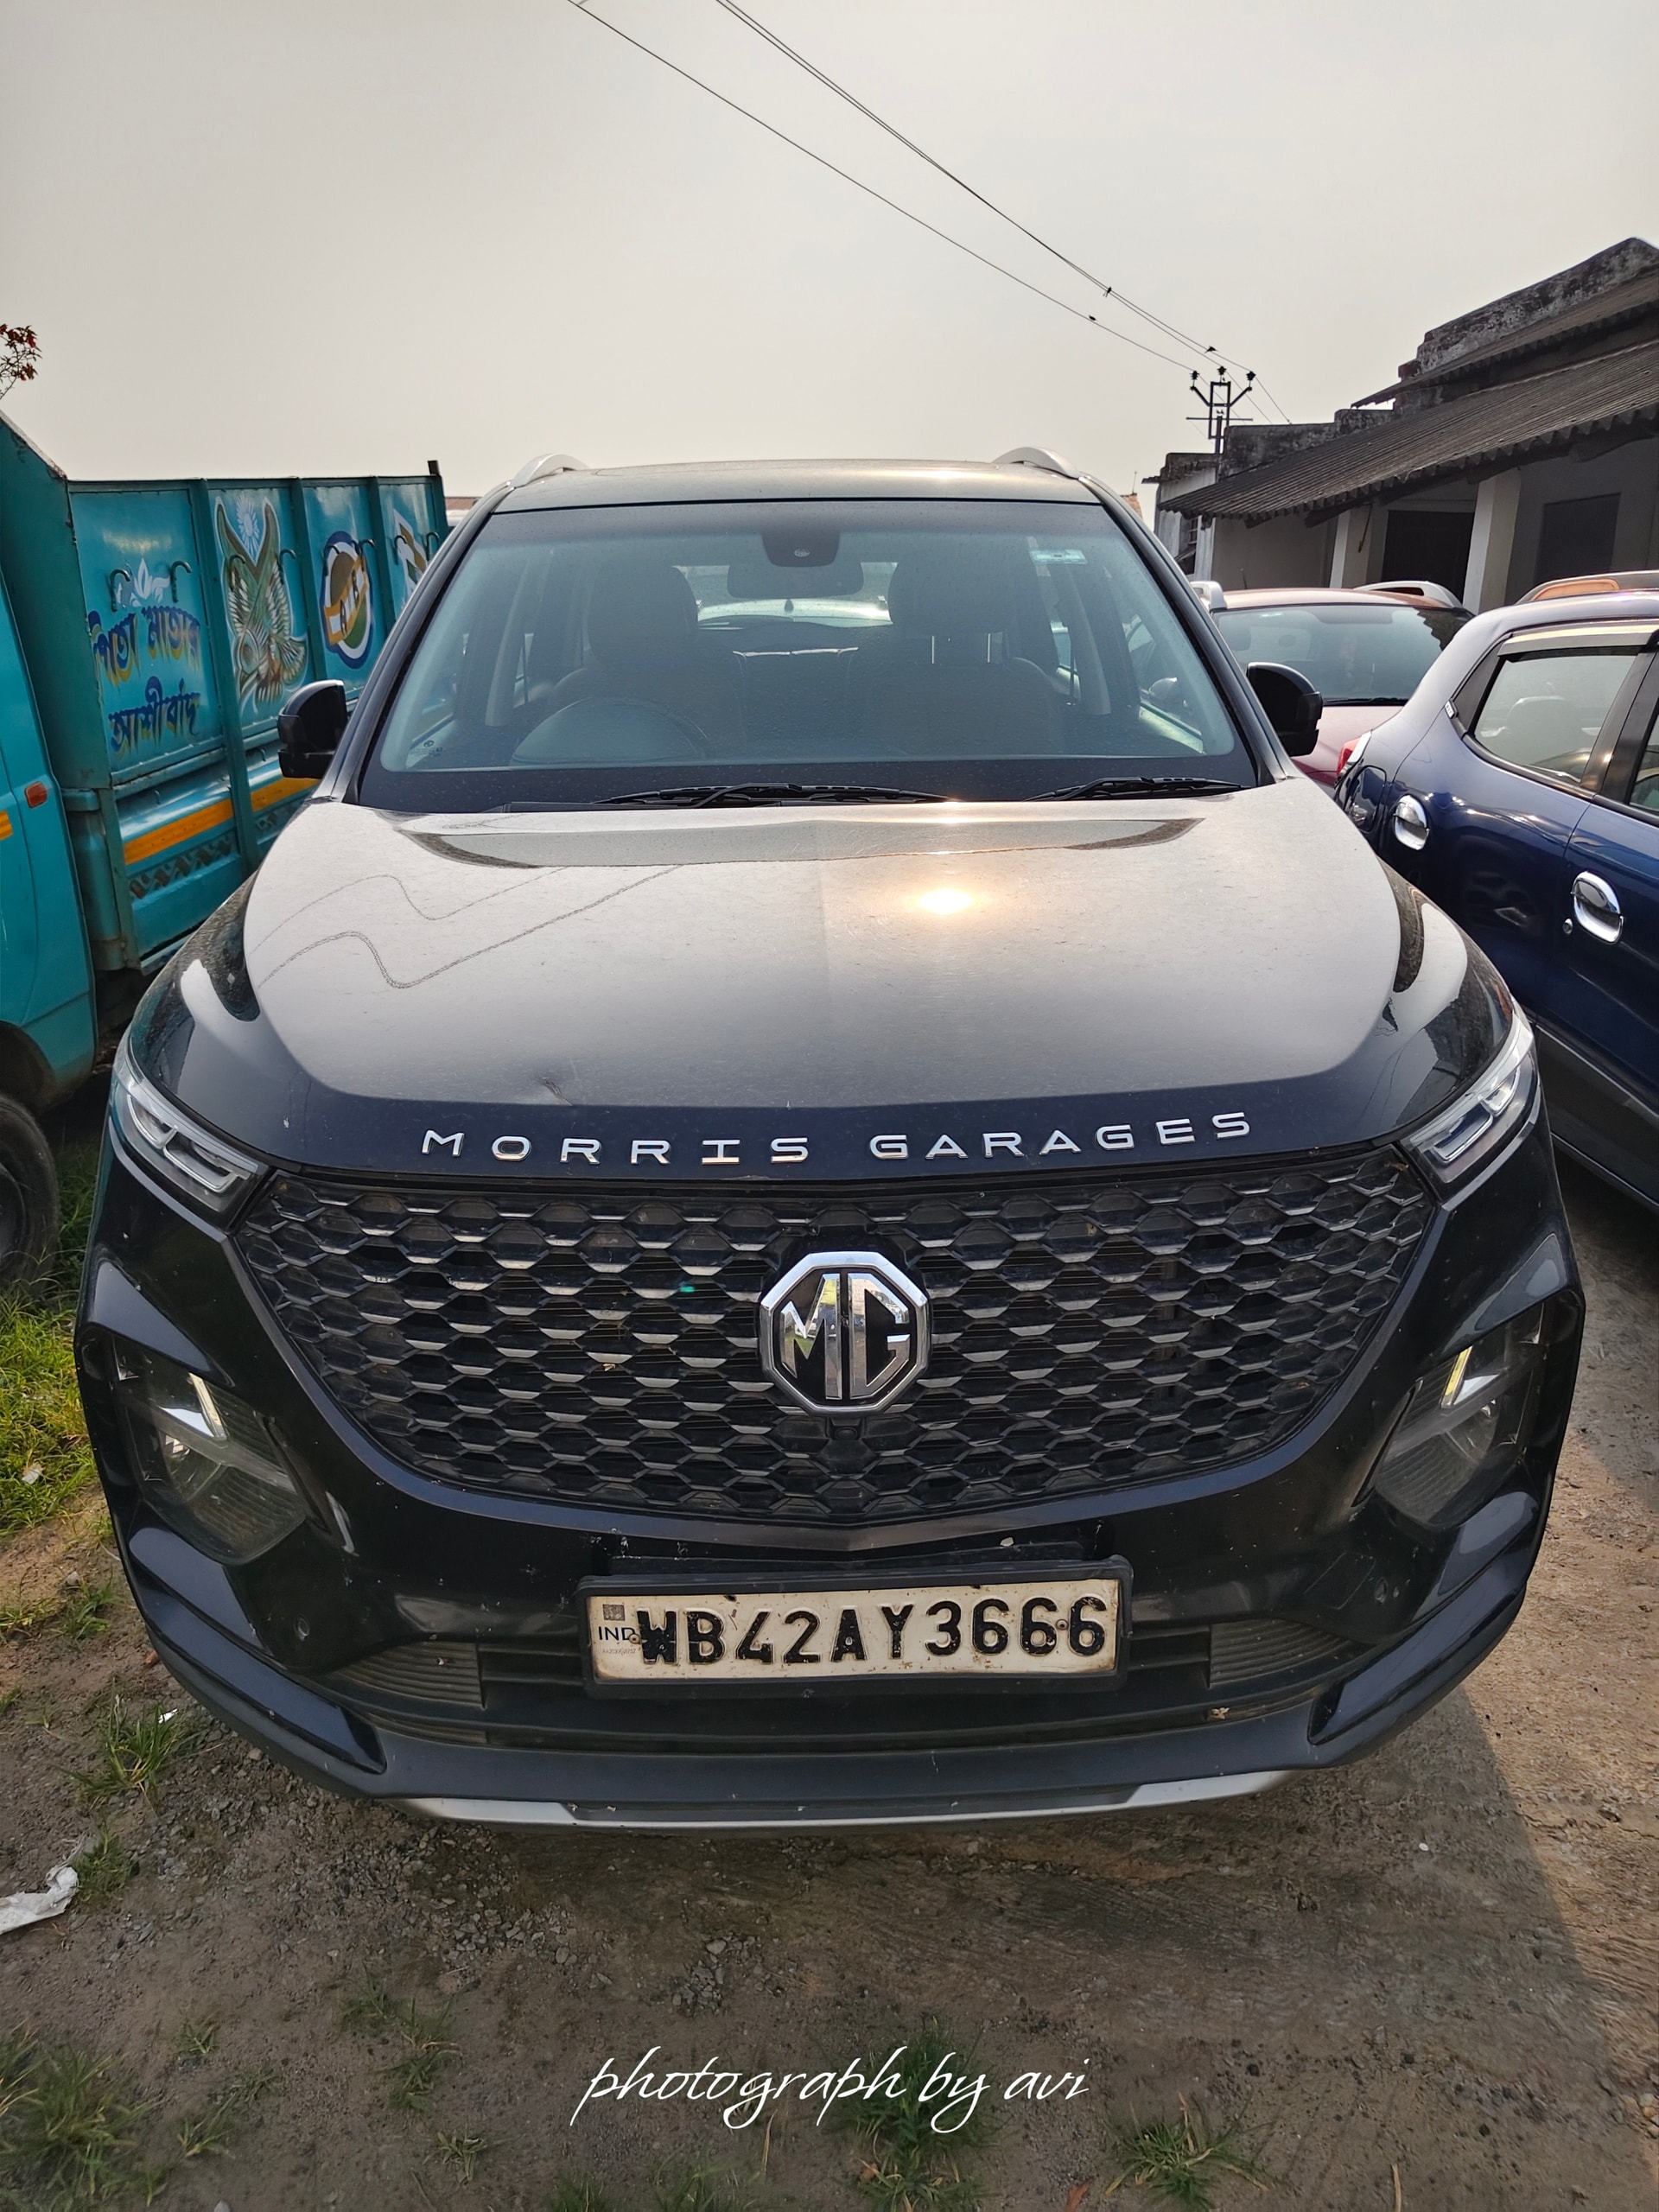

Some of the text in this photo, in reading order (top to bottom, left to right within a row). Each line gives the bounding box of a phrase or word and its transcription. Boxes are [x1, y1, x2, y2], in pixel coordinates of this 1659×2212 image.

[421, 1111, 1251, 1165] MORRIS GARAGES
[780, 1273, 911, 1400] MG
[598, 1626, 637, 1641] IND
[636, 1597, 1108, 1665] WB42AY3666
